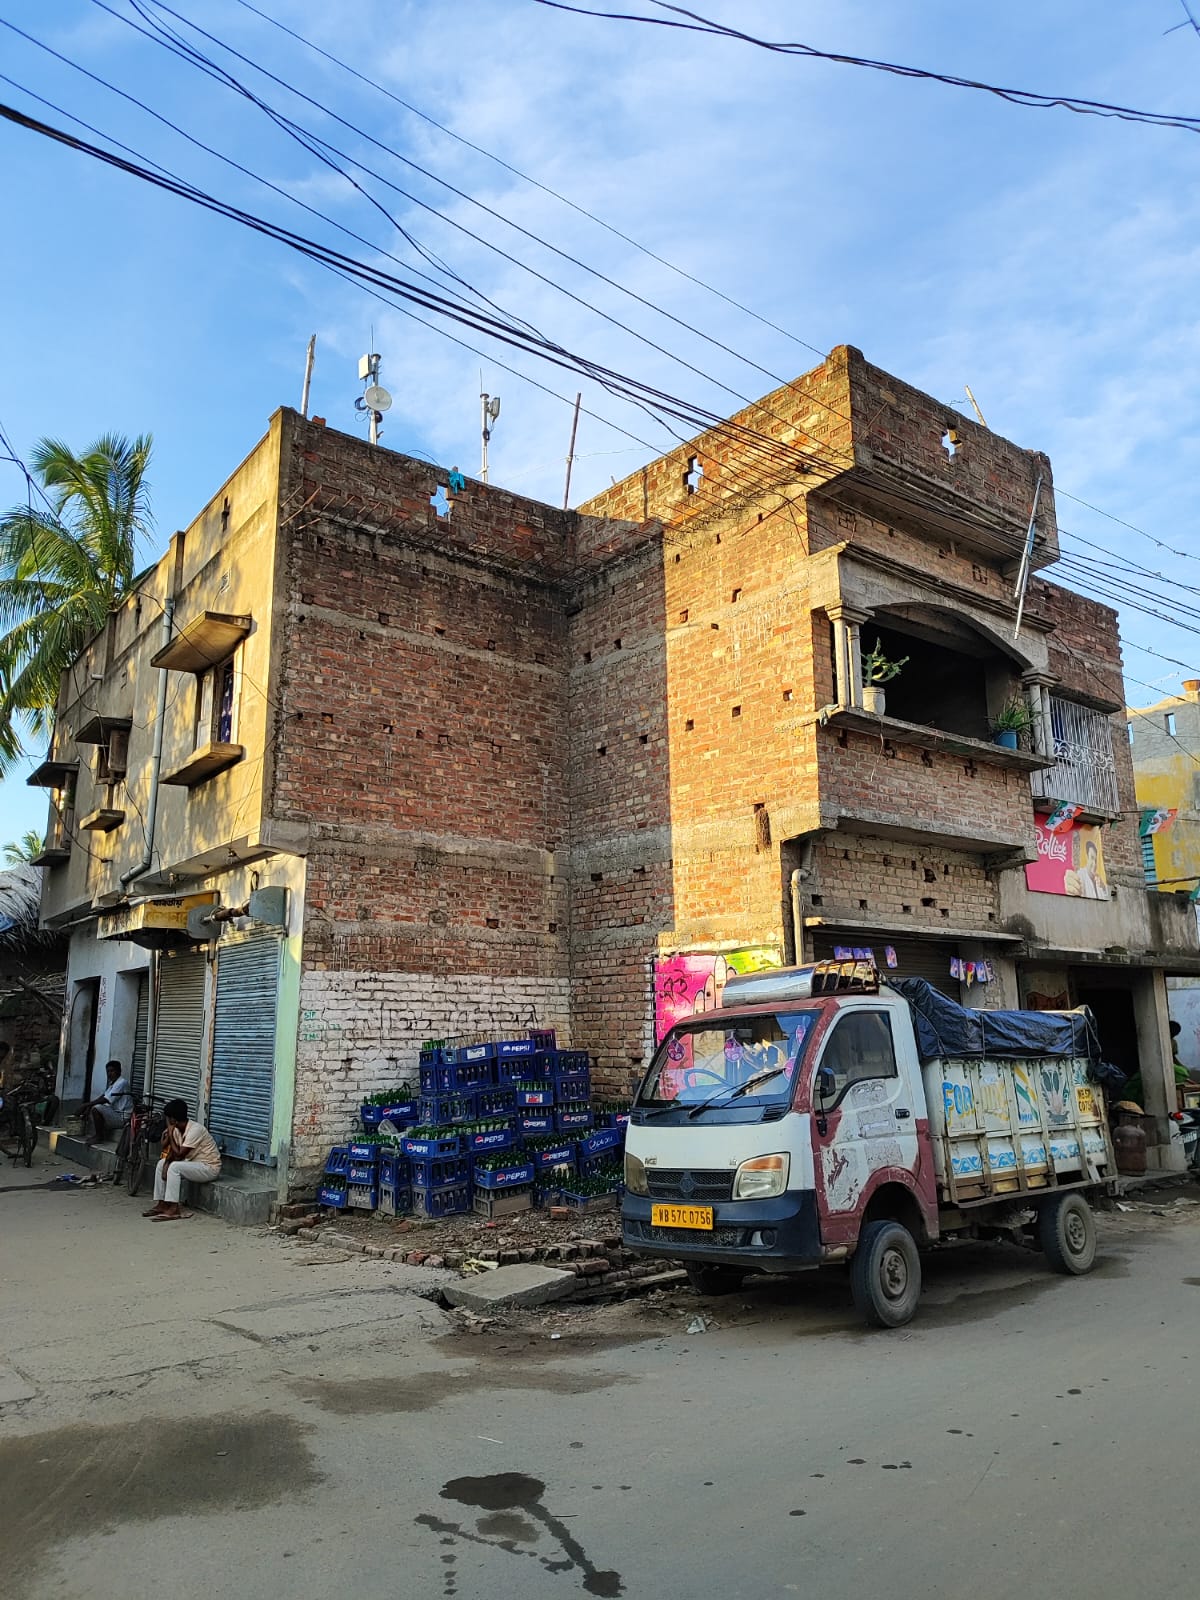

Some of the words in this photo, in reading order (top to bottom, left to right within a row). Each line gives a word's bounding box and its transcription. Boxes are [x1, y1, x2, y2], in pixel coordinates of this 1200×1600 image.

[511, 1044, 530, 1052] PEPSI
[389, 1106, 411, 1114] PEPSI
[570, 1114, 588, 1122] PEPSI
[483, 1134, 504, 1143] PEPSI
[412, 1144, 428, 1154] PEPSI
[548, 1150, 570, 1160] PEPSI
[505, 1171, 527, 1181] PEPSI
[659, 1209, 669, 1222] WB
[671, 1209, 687, 1223] 57C
[689, 1210, 711, 1225] 0756
